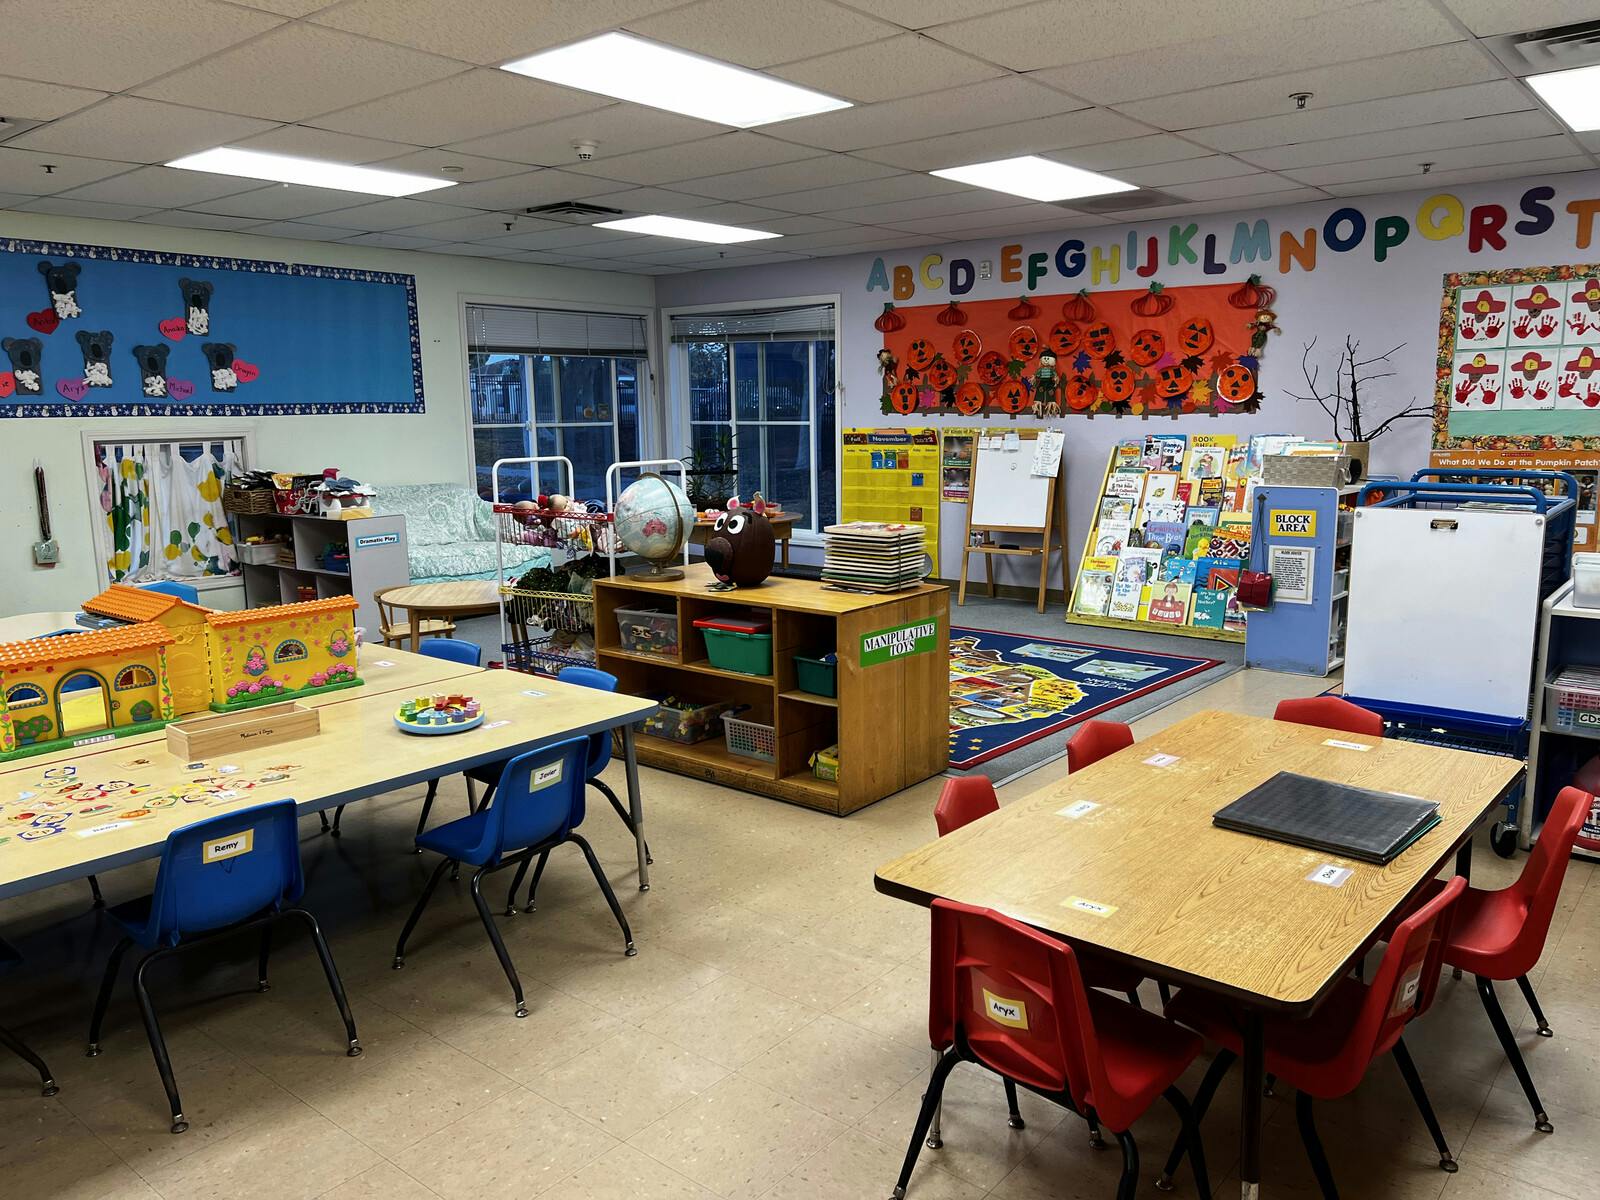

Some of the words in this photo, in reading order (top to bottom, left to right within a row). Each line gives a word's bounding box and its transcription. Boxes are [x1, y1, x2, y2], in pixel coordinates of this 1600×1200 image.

[866, 257, 890, 292] A
[894, 265, 915, 300] B
[919, 254, 943, 290] C
[949, 259, 975, 295] D
[1001, 244, 1023, 283] E
[1028, 252, 1048, 290] F
[1055, 239, 1086, 278] G
[1091, 243, 1121, 285] H
[1127, 230, 1137, 270] I
[1137, 236, 1158, 277] J
[1168, 223, 1199, 265] K
[1203, 234, 1227, 275] L
[1229, 218, 1272, 264] M
[1279, 228, 1317, 274] N
[1323, 207, 1366, 252] O
[1374, 216, 1409, 262] P
[1416, 193, 1465, 241] Q
[1468, 204, 1508, 253] R
[1515, 186, 1556, 235] S
[1566, 199, 1600, 249] T
[1535, 459, 1571, 467] Pumpkin
[1275, 515, 1310, 523] BLOCK
[1278, 524, 1307, 532] AREA
[865, 624, 934, 650] MANIPULATIVE
[891, 640, 914, 656] TOYS
[214, 841, 239, 853] Remy
[993, 1002, 1016, 1017] Aryx
